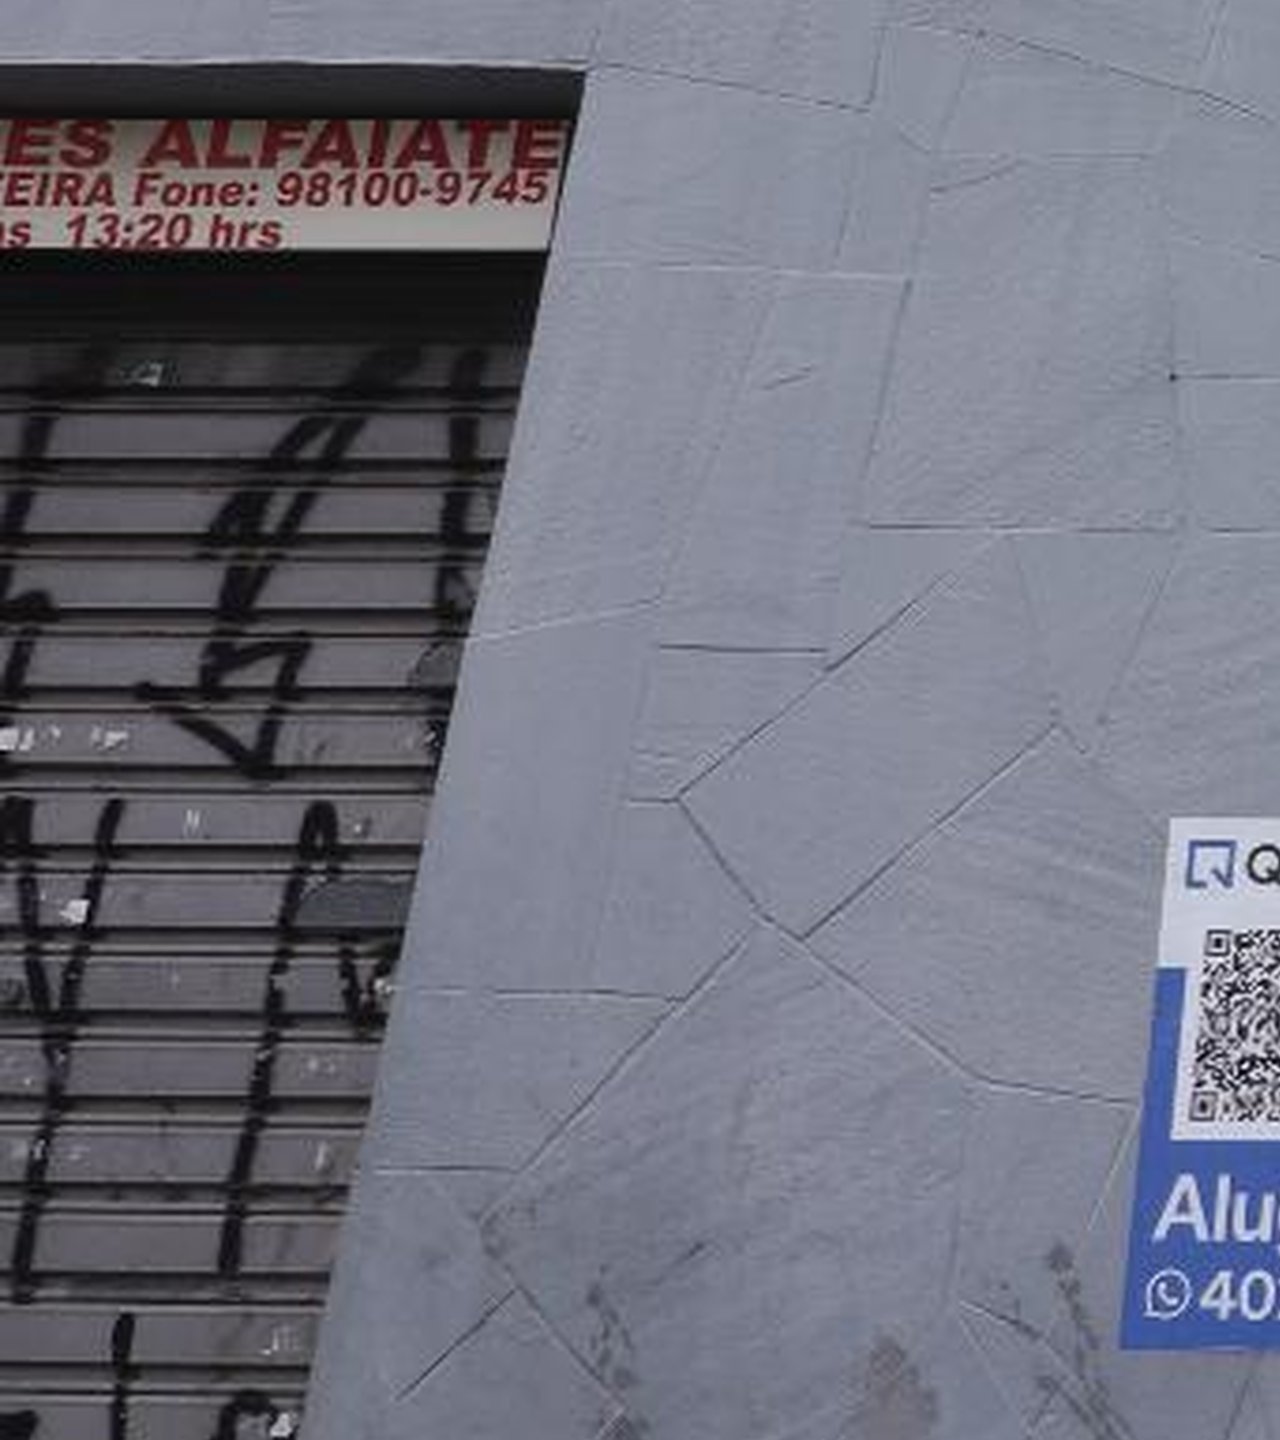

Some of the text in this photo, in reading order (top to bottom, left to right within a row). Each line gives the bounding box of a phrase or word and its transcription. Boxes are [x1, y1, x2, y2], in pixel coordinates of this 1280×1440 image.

[137, 119, 562, 170] ALFAIATE
[0, 170, 549, 208] EIRA Fone: 98100-9745
[65, 212, 193, 249] 13:20
[208, 212, 283, 249] hrs
